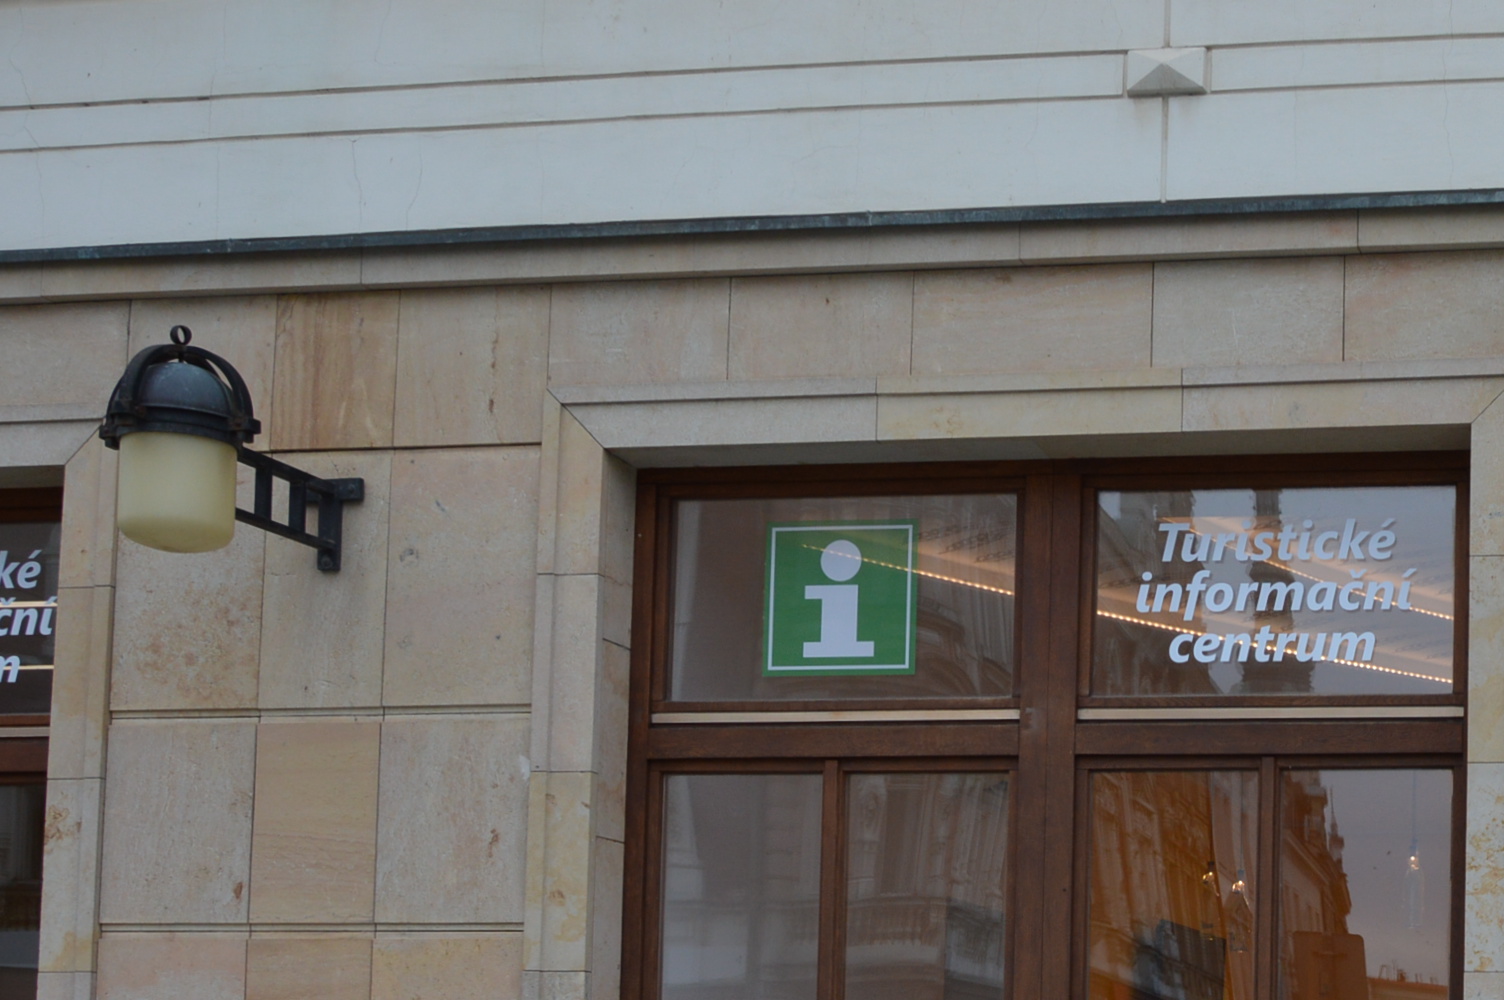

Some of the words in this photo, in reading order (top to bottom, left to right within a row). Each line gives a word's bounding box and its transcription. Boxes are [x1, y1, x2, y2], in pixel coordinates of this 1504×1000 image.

[1158, 518, 1396, 562] Turistické
[1135, 568, 1417, 621] informační
[1168, 625, 1377, 663] centrum
